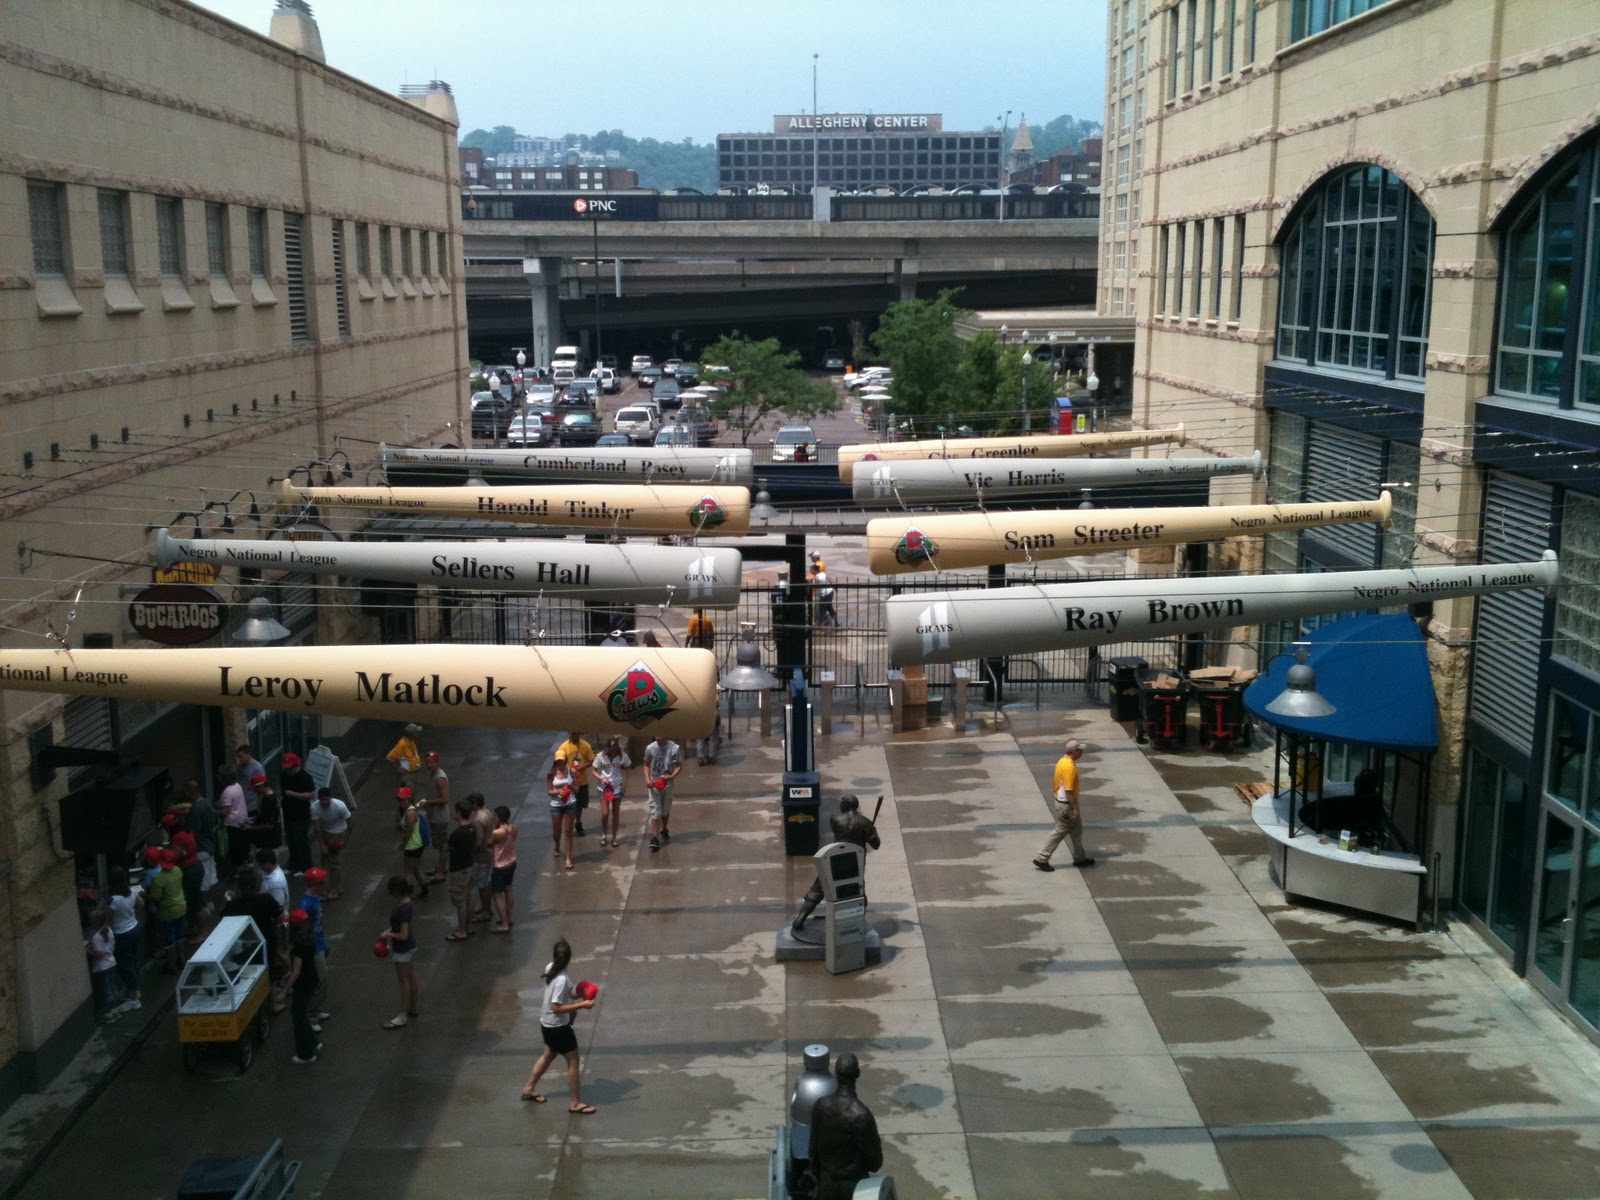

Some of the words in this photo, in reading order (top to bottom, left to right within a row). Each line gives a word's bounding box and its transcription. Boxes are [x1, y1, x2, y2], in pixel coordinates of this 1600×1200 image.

[789, 116, 868, 128] ALLEGHENY
[874, 116, 928, 127] CENTER
[589, 200, 617, 211] PNC
[971, 444, 1040, 458] Greenlee
[523, 456, 626, 473] Cumberland
[641, 460, 688, 479] Posey
[964, 472, 993, 488] Vic
[1008, 469, 1065, 486] Harris
[1169, 464, 1209, 474] National
[337, 494, 383, 505] National
[389, 497, 427, 507] League
[477, 496, 547, 516] Harold
[565, 500, 635, 520] Tinker
[1230, 516, 1266, 529] Negro
[1273, 510, 1324, 525] National
[1331, 507, 1373, 521] League
[1004, 530, 1055, 550] Sam
[1074, 522, 1165, 545] Streeter
[178, 545, 218, 560] Negro
[226, 547, 282, 563] National
[290, 551, 338, 567] League
[431, 554, 515, 582] Sellers
[537, 560, 590, 585] Hall
[684, 574, 717, 582] GRAYS
[1353, 584, 1399, 600] Negro
[1407, 575, 1472, 593] National
[1481, 571, 1535, 588] League
[134, 603, 220, 629] BUCAROOS
[1063, 606, 1122, 634] Ray
[1147, 596, 1244, 625] Brown
[916, 623, 954, 635] GRAYS
[62, 666, 129, 688] League
[218, 665, 324, 706] Leroy
[356, 670, 508, 708] Matlock
